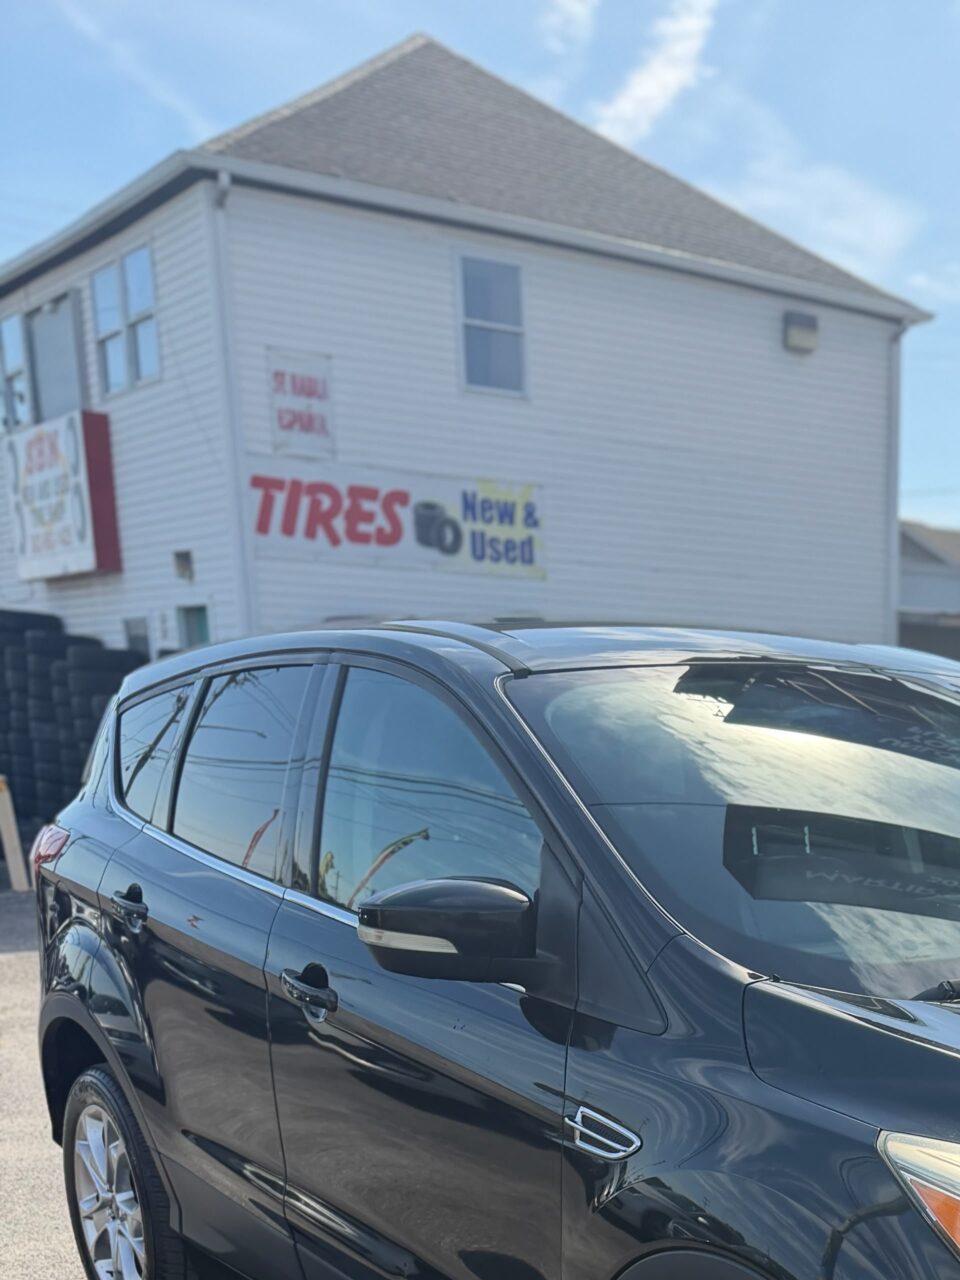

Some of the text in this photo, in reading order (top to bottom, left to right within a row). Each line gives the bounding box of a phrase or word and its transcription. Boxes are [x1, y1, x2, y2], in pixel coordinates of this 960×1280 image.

[249, 473, 412, 549] TIRES
[460, 489, 540, 528] New &
[469, 530, 536, 565] Used
